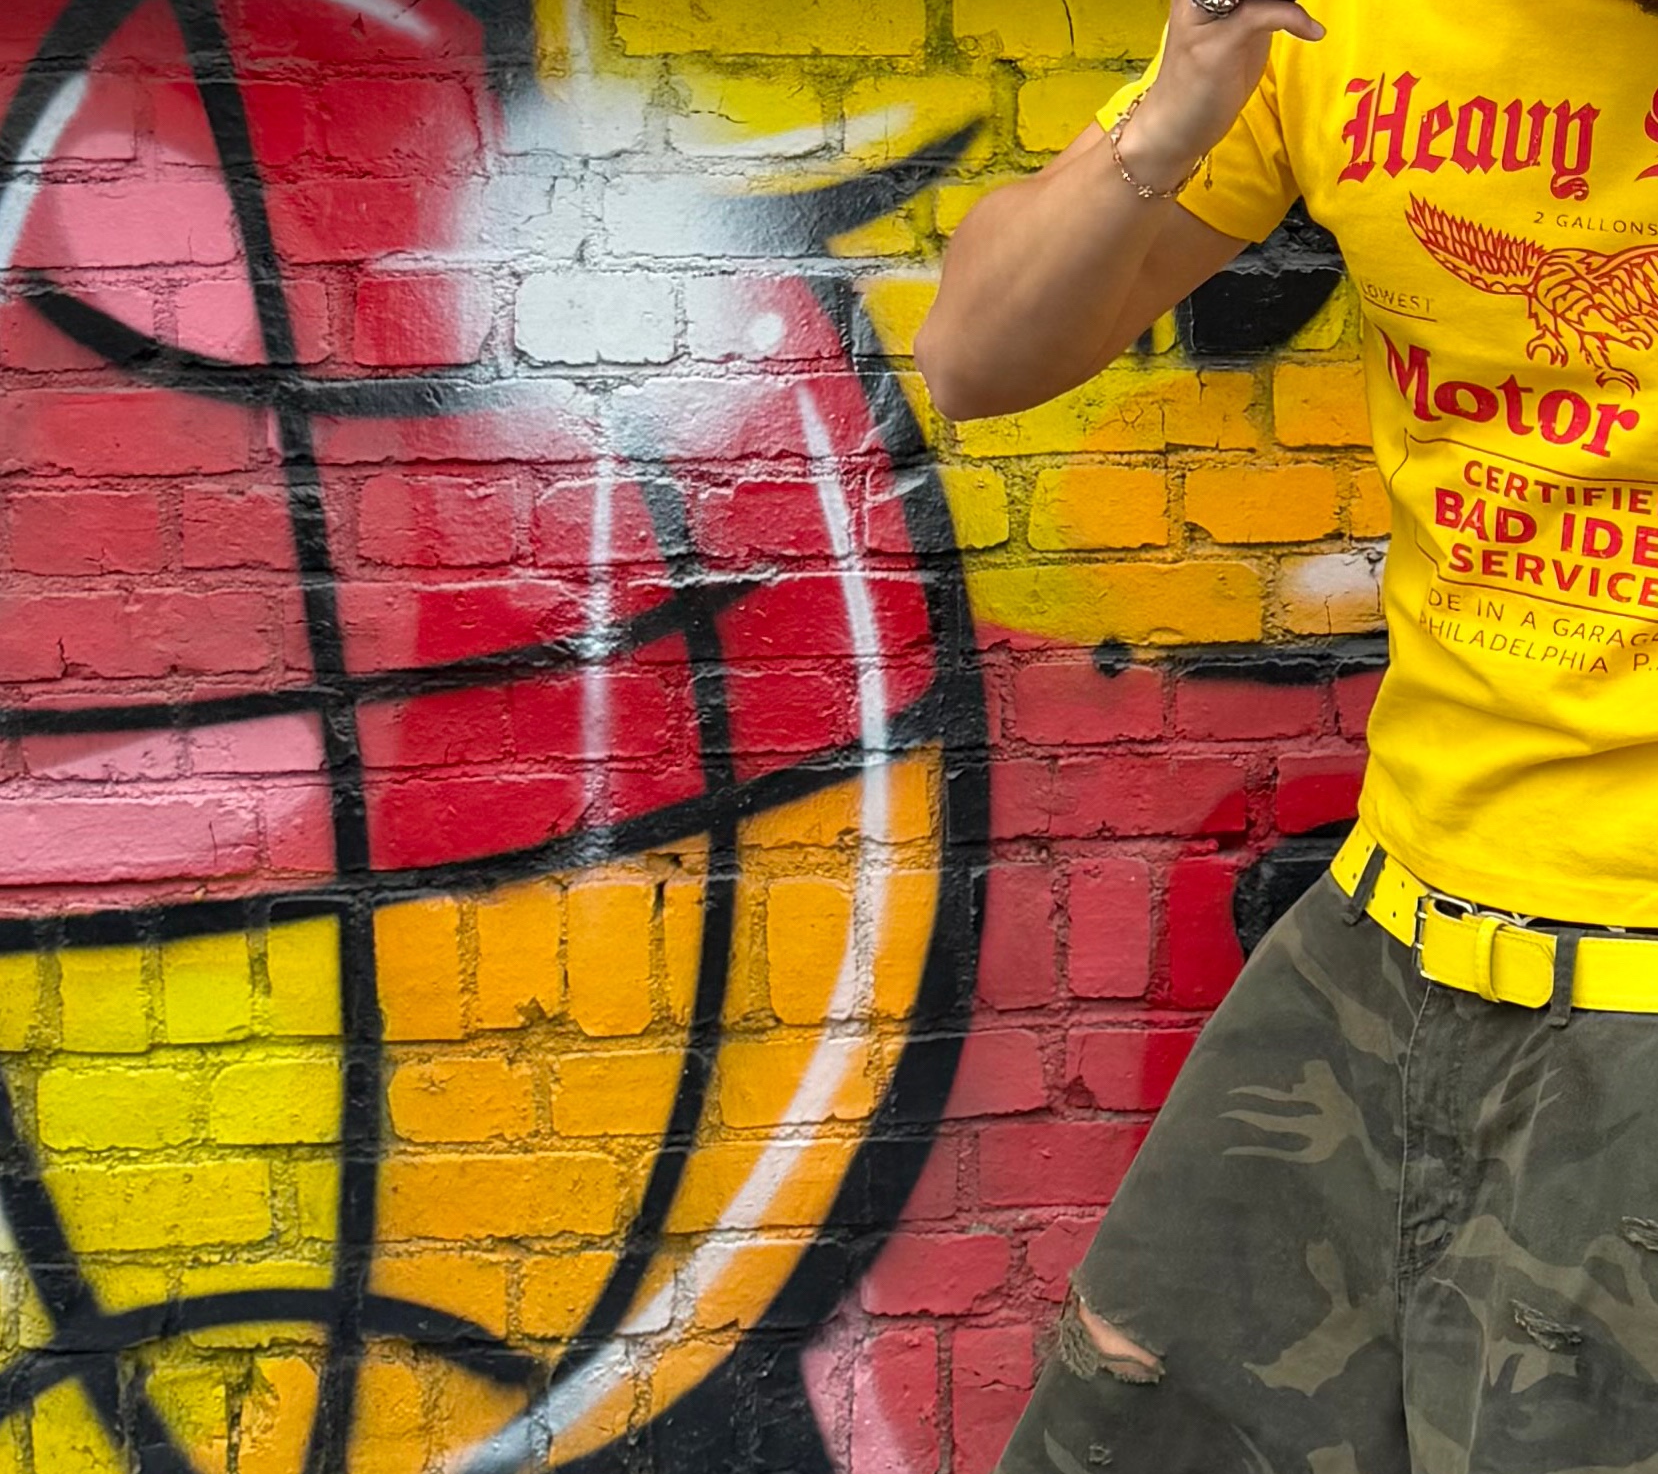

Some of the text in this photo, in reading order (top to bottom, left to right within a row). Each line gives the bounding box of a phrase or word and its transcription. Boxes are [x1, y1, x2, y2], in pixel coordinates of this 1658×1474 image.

[1337, 71, 1601, 201] Heavy
[1534, 211, 1658, 237] 2 GALLONS
[1374, 323, 1639, 459] Motor
[1435, 487, 1538, 545] BAD
[1419, 609, 1609, 674] PHILADELPHIA
[1476, 598, 1505, 622] IN
[1520, 611, 1536, 630] A
